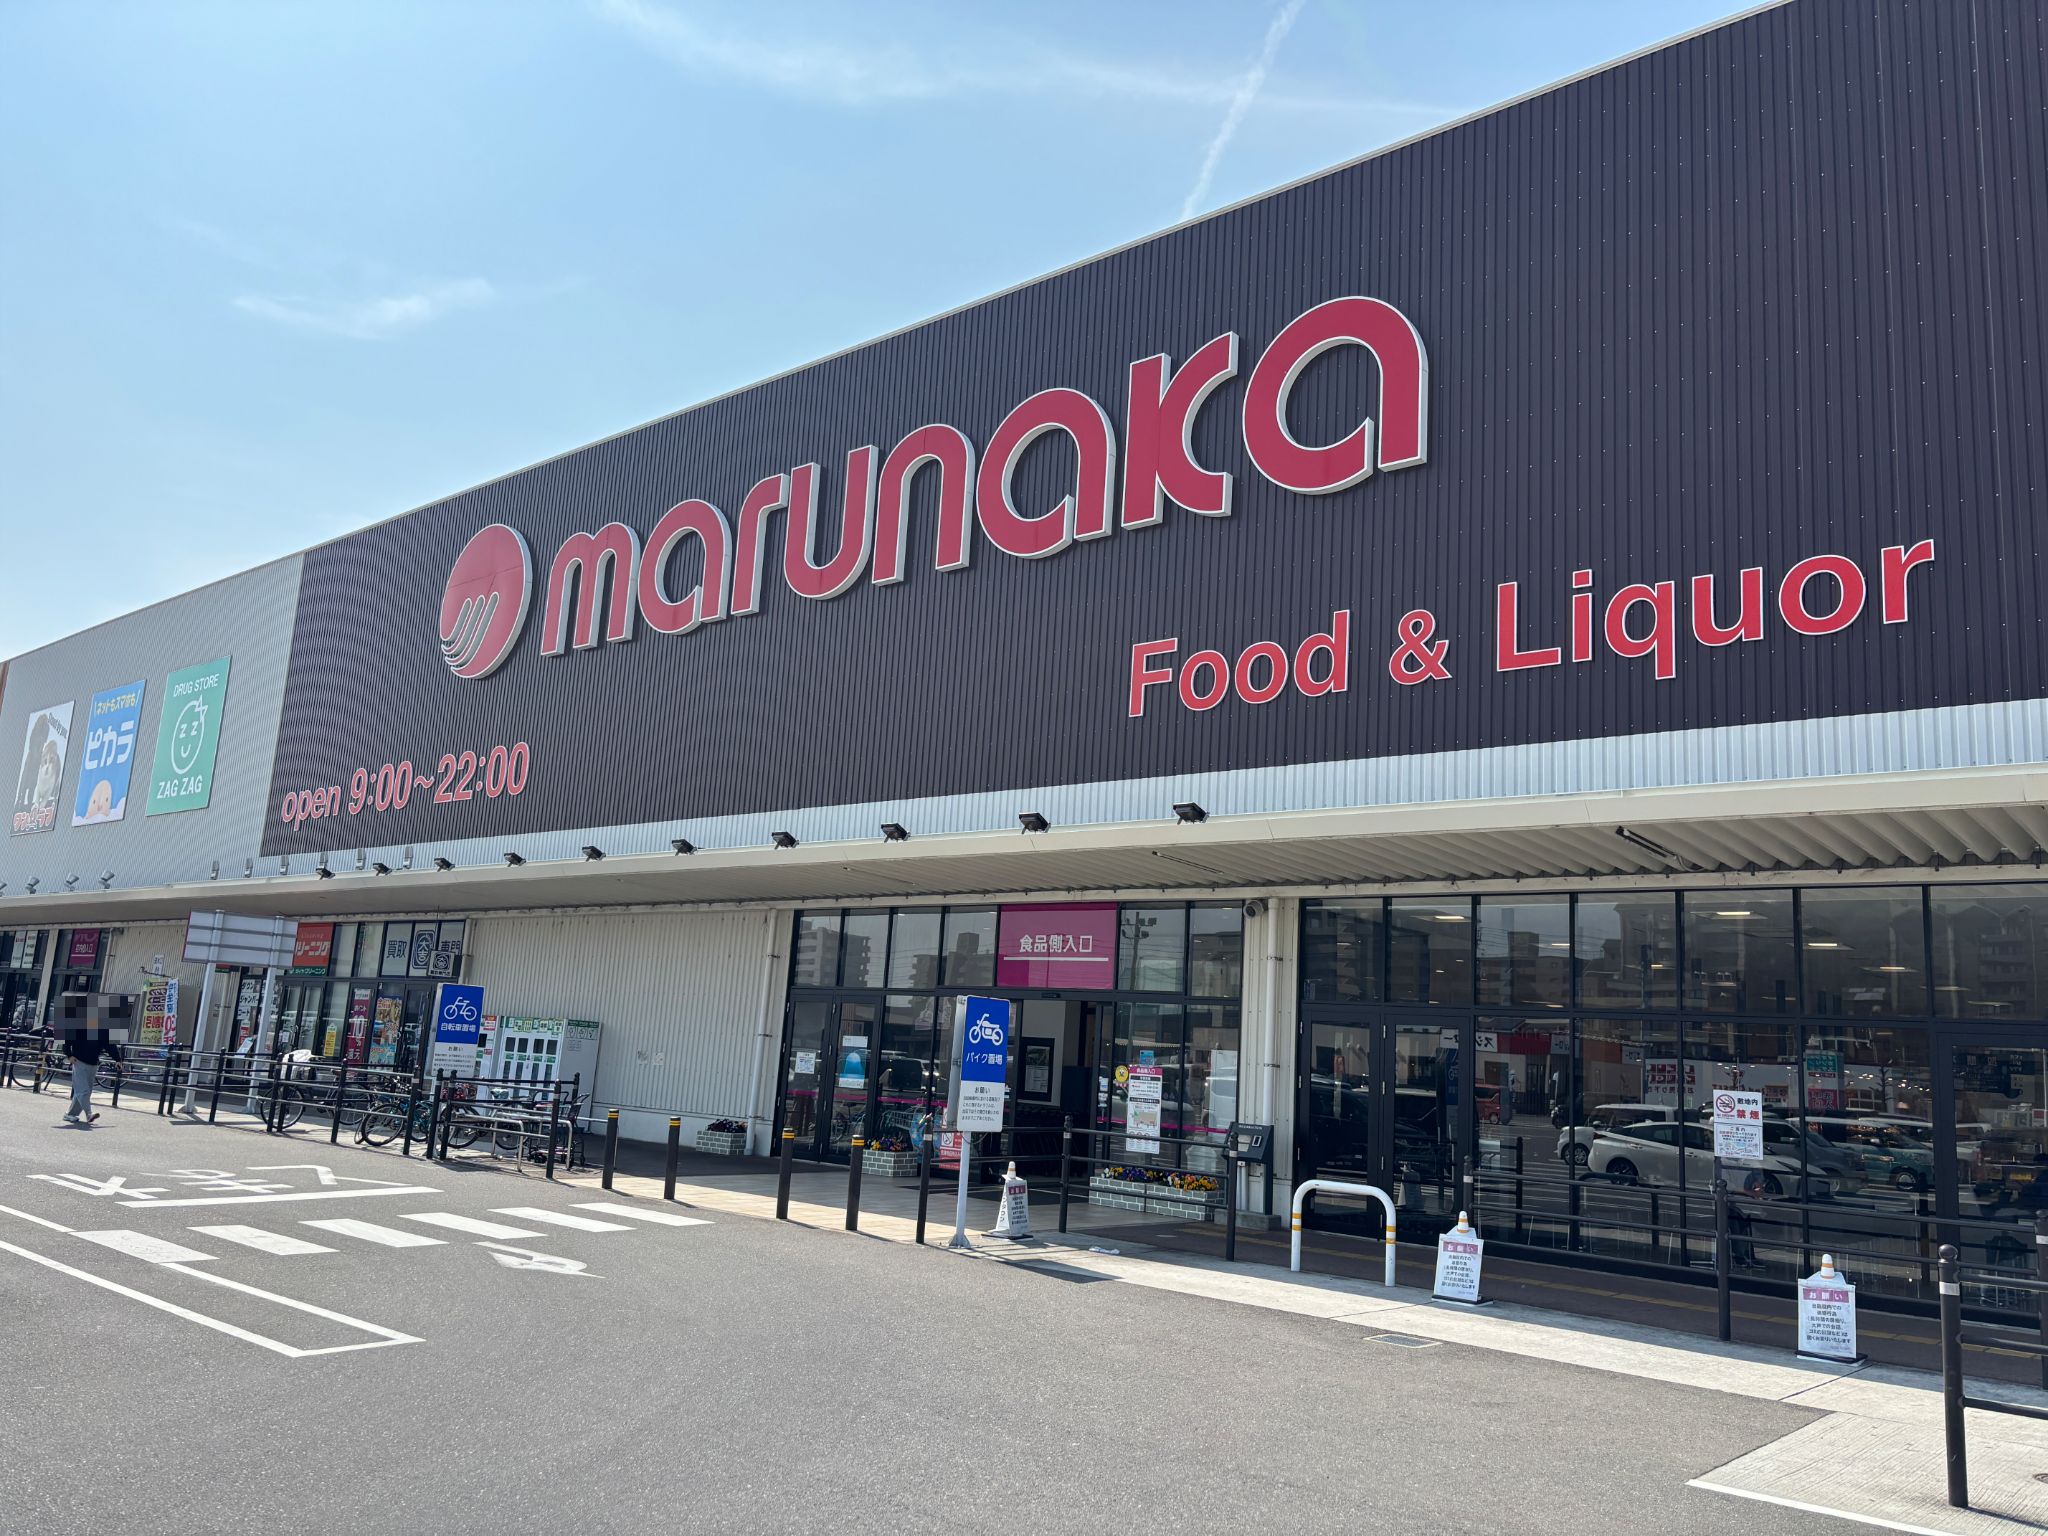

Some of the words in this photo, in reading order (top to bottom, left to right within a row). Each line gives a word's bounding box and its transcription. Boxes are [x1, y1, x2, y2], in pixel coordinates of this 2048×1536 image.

[540, 295, 1430, 658] marunaka
[1127, 608, 1350, 718] Food
[1388, 609, 1453, 685] &
[1496, 538, 1936, 681] Liquor
[173, 680, 193, 697] DRUG
[194, 673, 220, 692] STORE
[85, 720, 135, 770] ピカラ
[157, 780, 178, 799] ZAG
[180, 775, 203, 795] ZAG
[282, 784, 341, 831] open
[387, 940, 407, 959] 買取
[1019, 934, 1094, 954] 食品側入口
[441, 1022, 477, 1033] 自転車置場
[966, 1053, 1003, 1065] バイク置場
[974, 1086, 991, 1095] お願い
[1737, 1097, 1759, 1106] 敷地内
[1736, 1109, 1760, 1120] 禁煙
[1809, 1292, 1842, 1300] お願い
